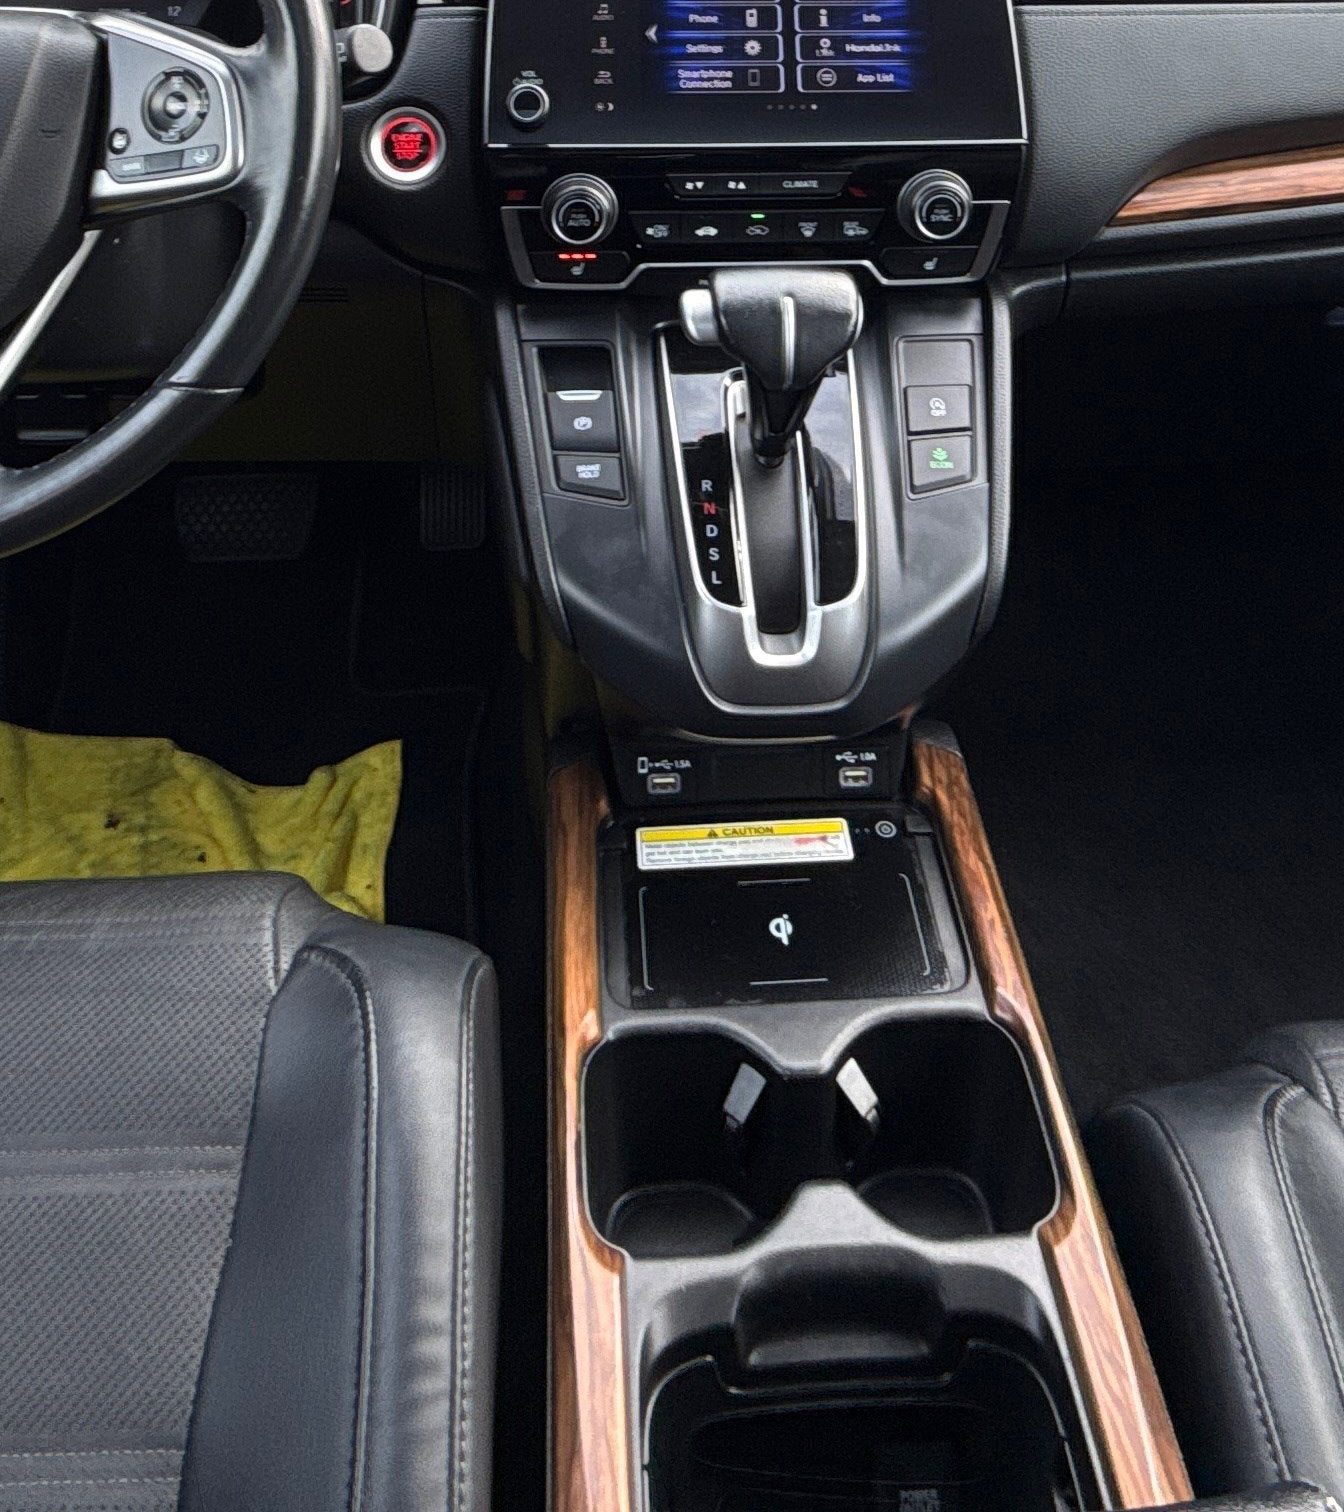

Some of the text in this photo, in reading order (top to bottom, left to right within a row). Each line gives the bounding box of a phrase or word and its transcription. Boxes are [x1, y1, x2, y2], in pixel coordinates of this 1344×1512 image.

[688, 13, 719, 24] Phone
[862, 13, 882, 23] Info
[685, 43, 724, 54] Settings
[677, 68, 734, 80] Smartphone
[856, 72, 895, 83] App List
[679, 79, 733, 89] Connection
[782, 179, 819, 189] CLIMATE
[567, 218, 592, 227] AUTO
[929, 213, 955, 223] SYNC
[701, 479, 713, 492] R
[703, 502, 717, 515] N
[706, 524, 719, 538] D
[708, 547, 720, 561] S
[711, 571, 723, 585] L
[722, 826, 774, 837] CAUTION
